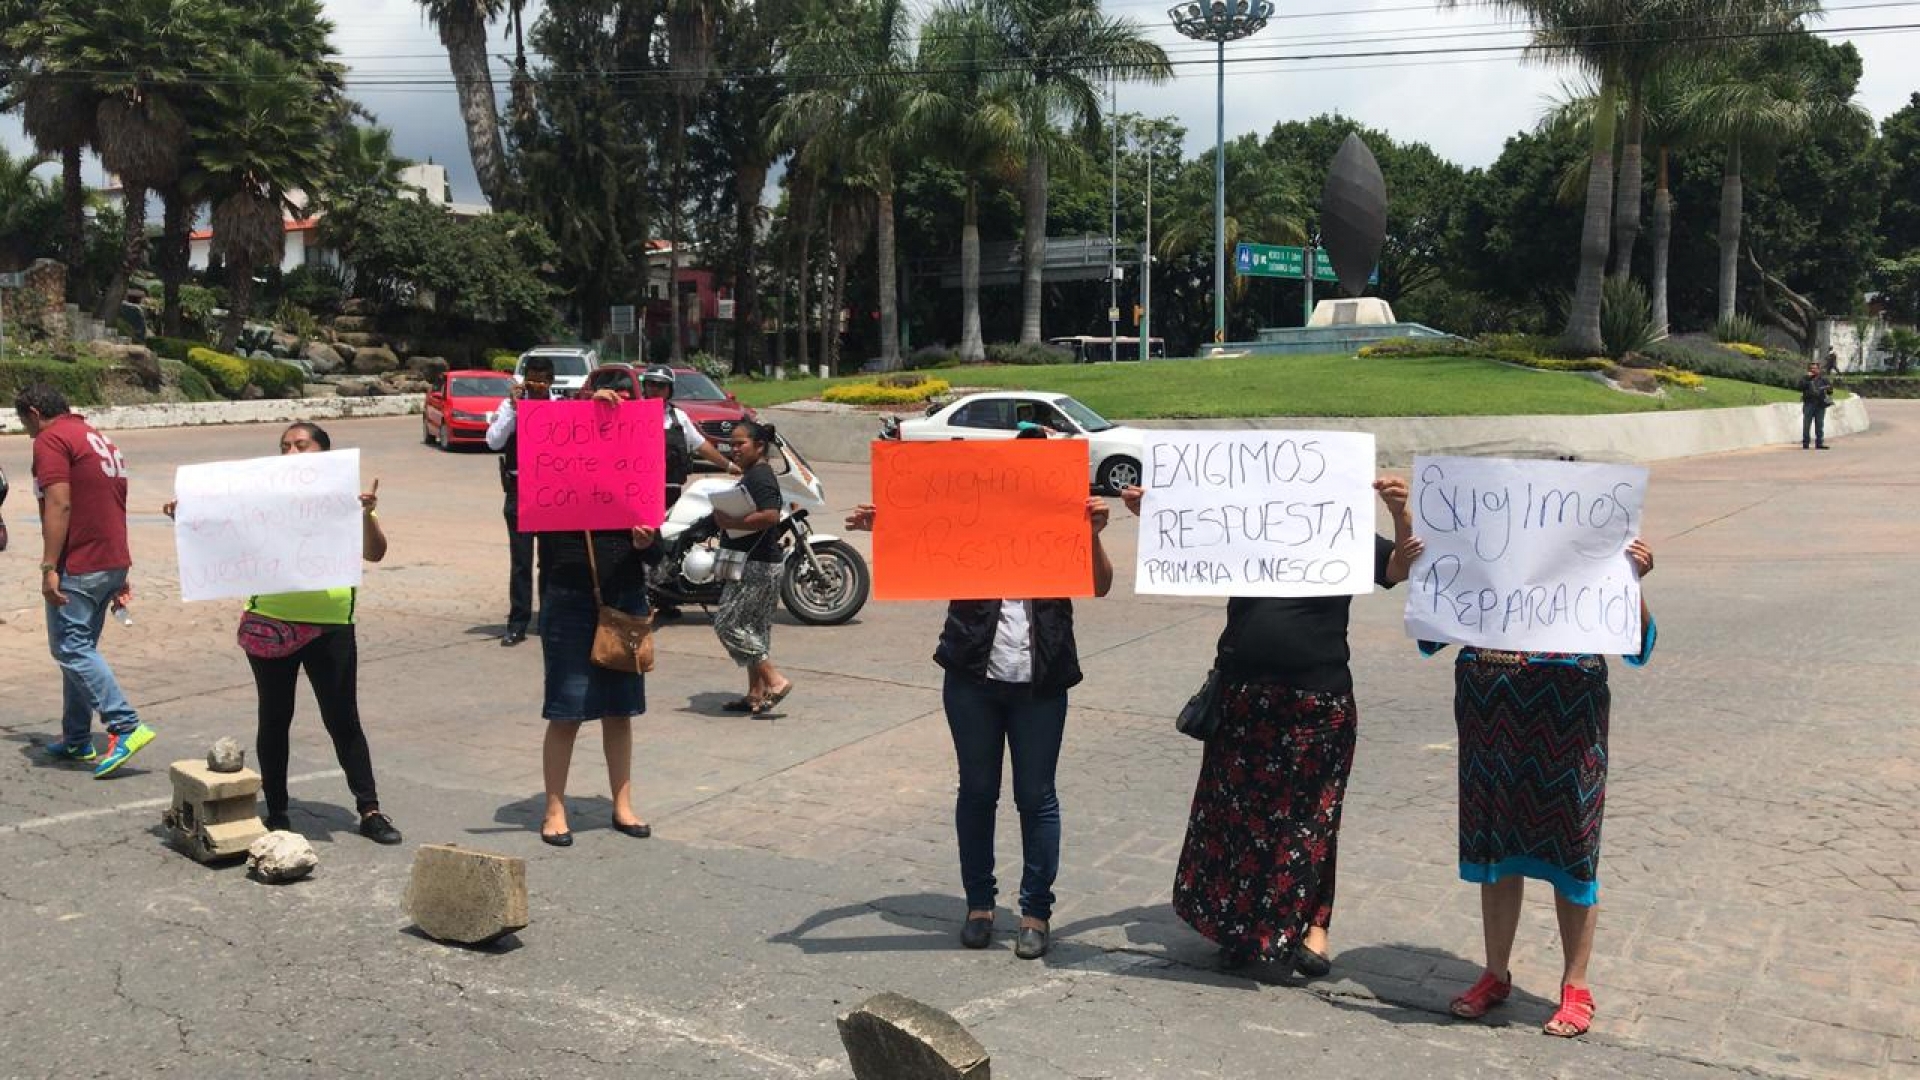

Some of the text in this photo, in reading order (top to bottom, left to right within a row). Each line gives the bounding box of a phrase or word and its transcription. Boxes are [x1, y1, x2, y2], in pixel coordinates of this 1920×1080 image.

[1151, 438, 1326, 489] EXIGIMOS
[1152, 500, 1356, 549] RESPUESTA
[1144, 556, 1351, 585] PRIMARIA UNESCO
